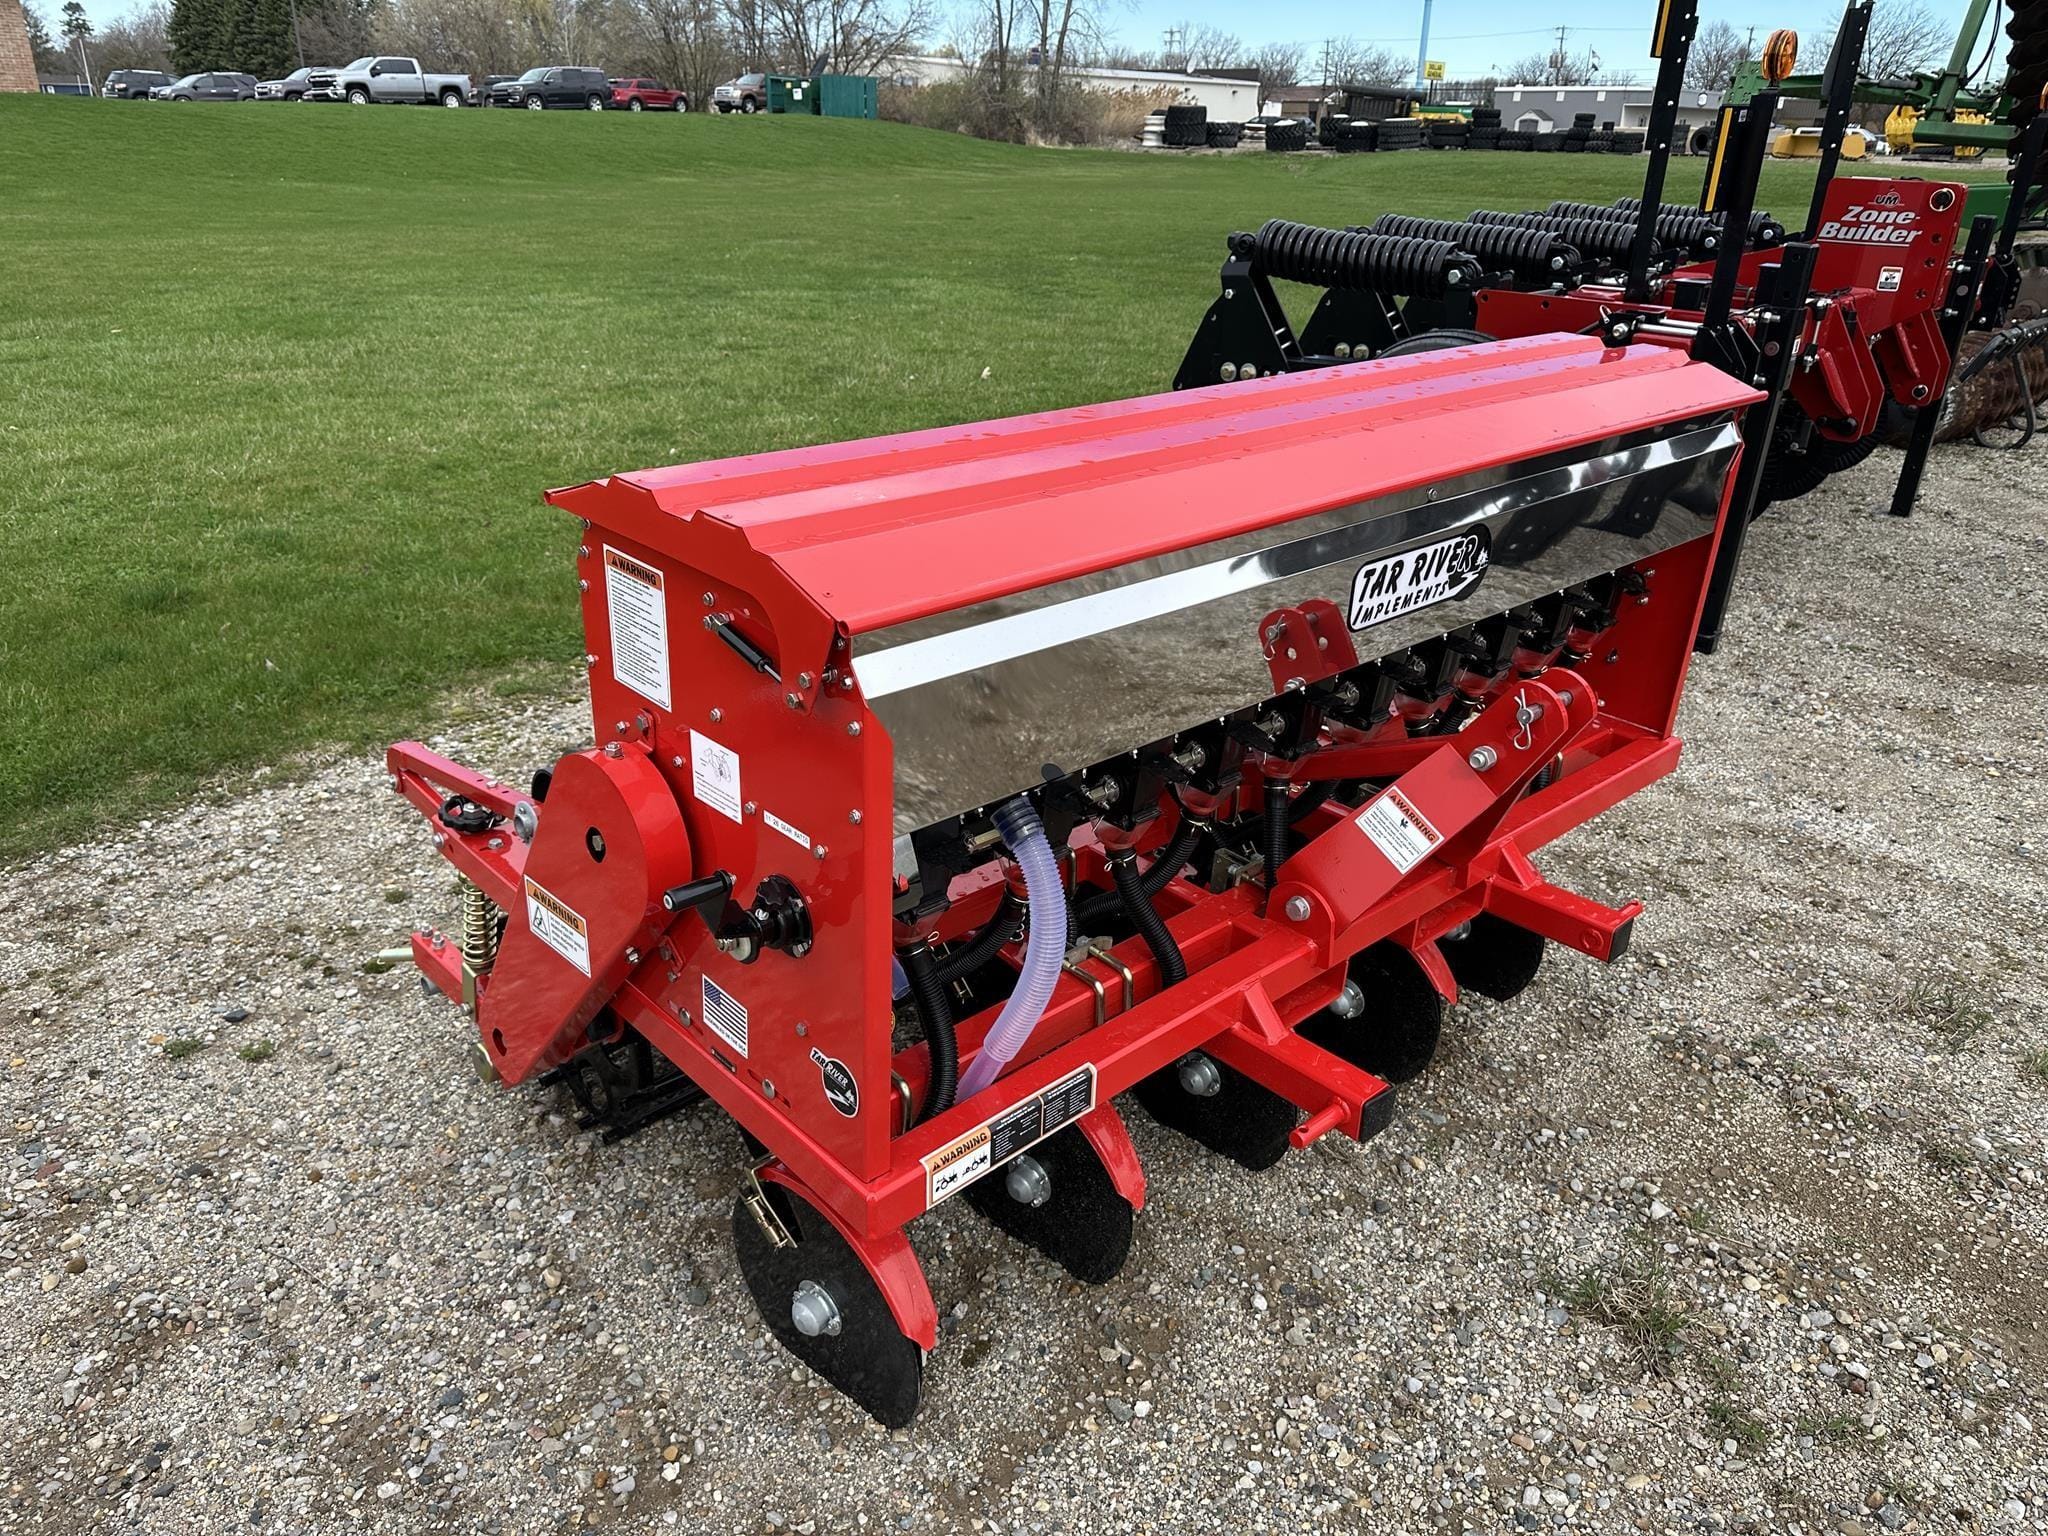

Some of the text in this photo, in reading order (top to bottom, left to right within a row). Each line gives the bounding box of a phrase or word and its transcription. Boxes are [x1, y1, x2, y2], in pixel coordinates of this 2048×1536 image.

[1841, 206, 1921, 224] Zone-
[1875, 194, 1899, 205] UM
[1818, 222, 1923, 243] Builder
[618, 558, 657, 586] WARNING
[1359, 535, 1478, 602] TAR RIVER
[1352, 580, 1449, 626] IMPLEMENTS
[1397, 798, 1436, 842] WARNING
[540, 890, 579, 929] WARNING
[812, 1051, 848, 1087] TAR RIVER
[940, 1132, 988, 1166] WARNING
